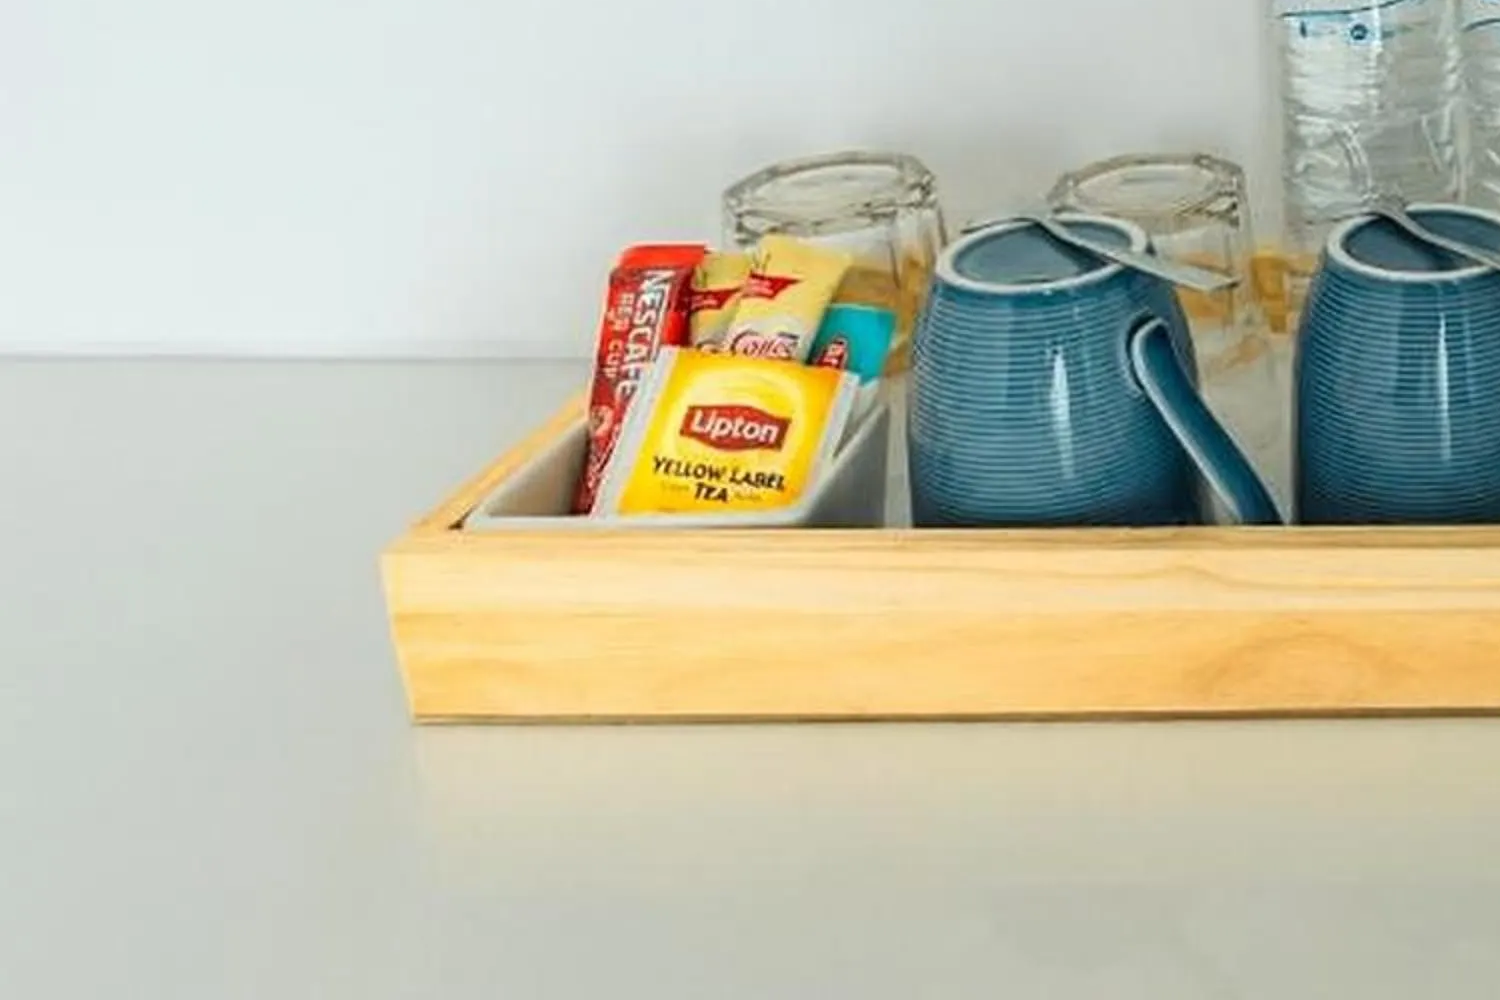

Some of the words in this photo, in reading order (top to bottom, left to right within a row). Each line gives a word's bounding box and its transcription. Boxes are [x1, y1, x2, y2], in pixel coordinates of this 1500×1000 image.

[690, 408, 780, 444] Lipton
[652, 455, 726, 481] YELLOW
[728, 467, 786, 492] LABEL
[694, 481, 729, 503] TEA
